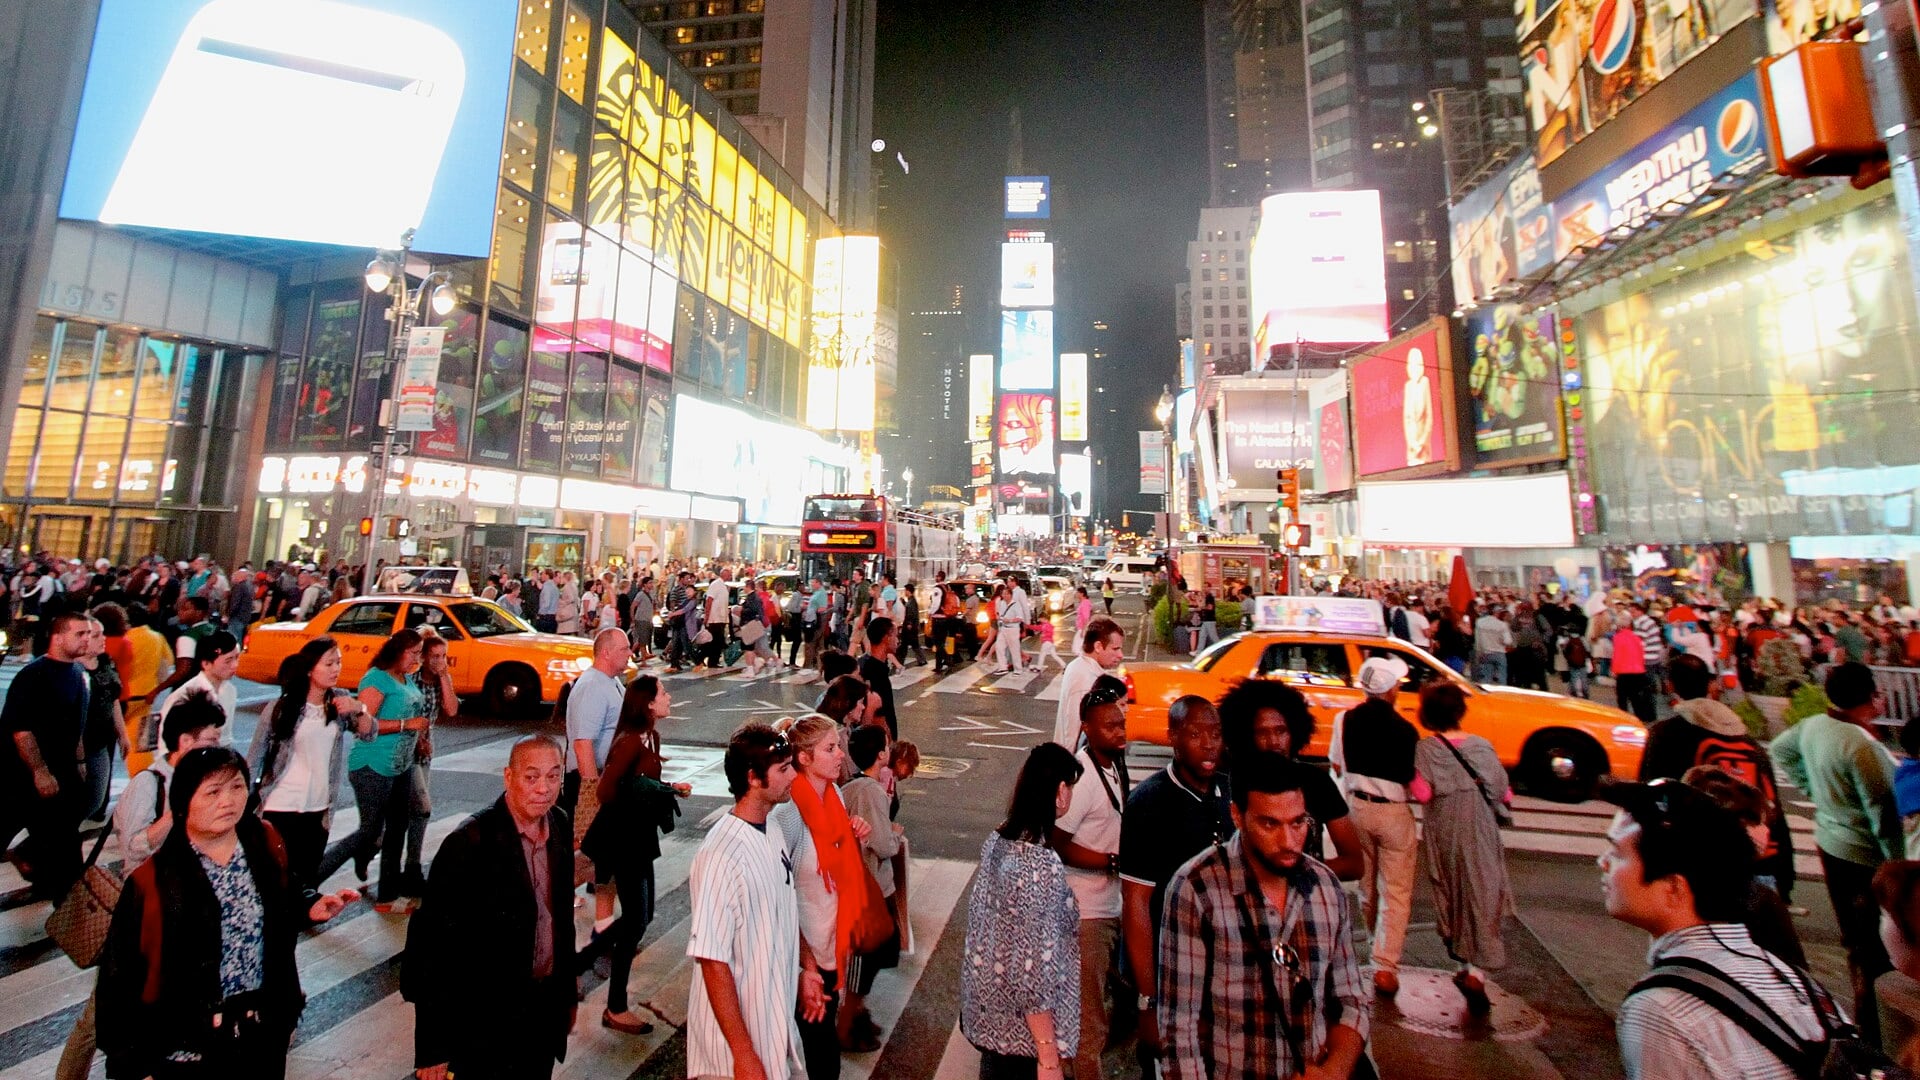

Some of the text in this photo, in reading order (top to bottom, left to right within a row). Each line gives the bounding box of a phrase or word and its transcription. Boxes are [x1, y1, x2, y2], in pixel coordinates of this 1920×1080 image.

[748, 195, 772, 237] THE
[716, 209, 758, 287] LION
[760, 242, 799, 313] KING
[1735, 495, 1798, 517] SUNDAY
